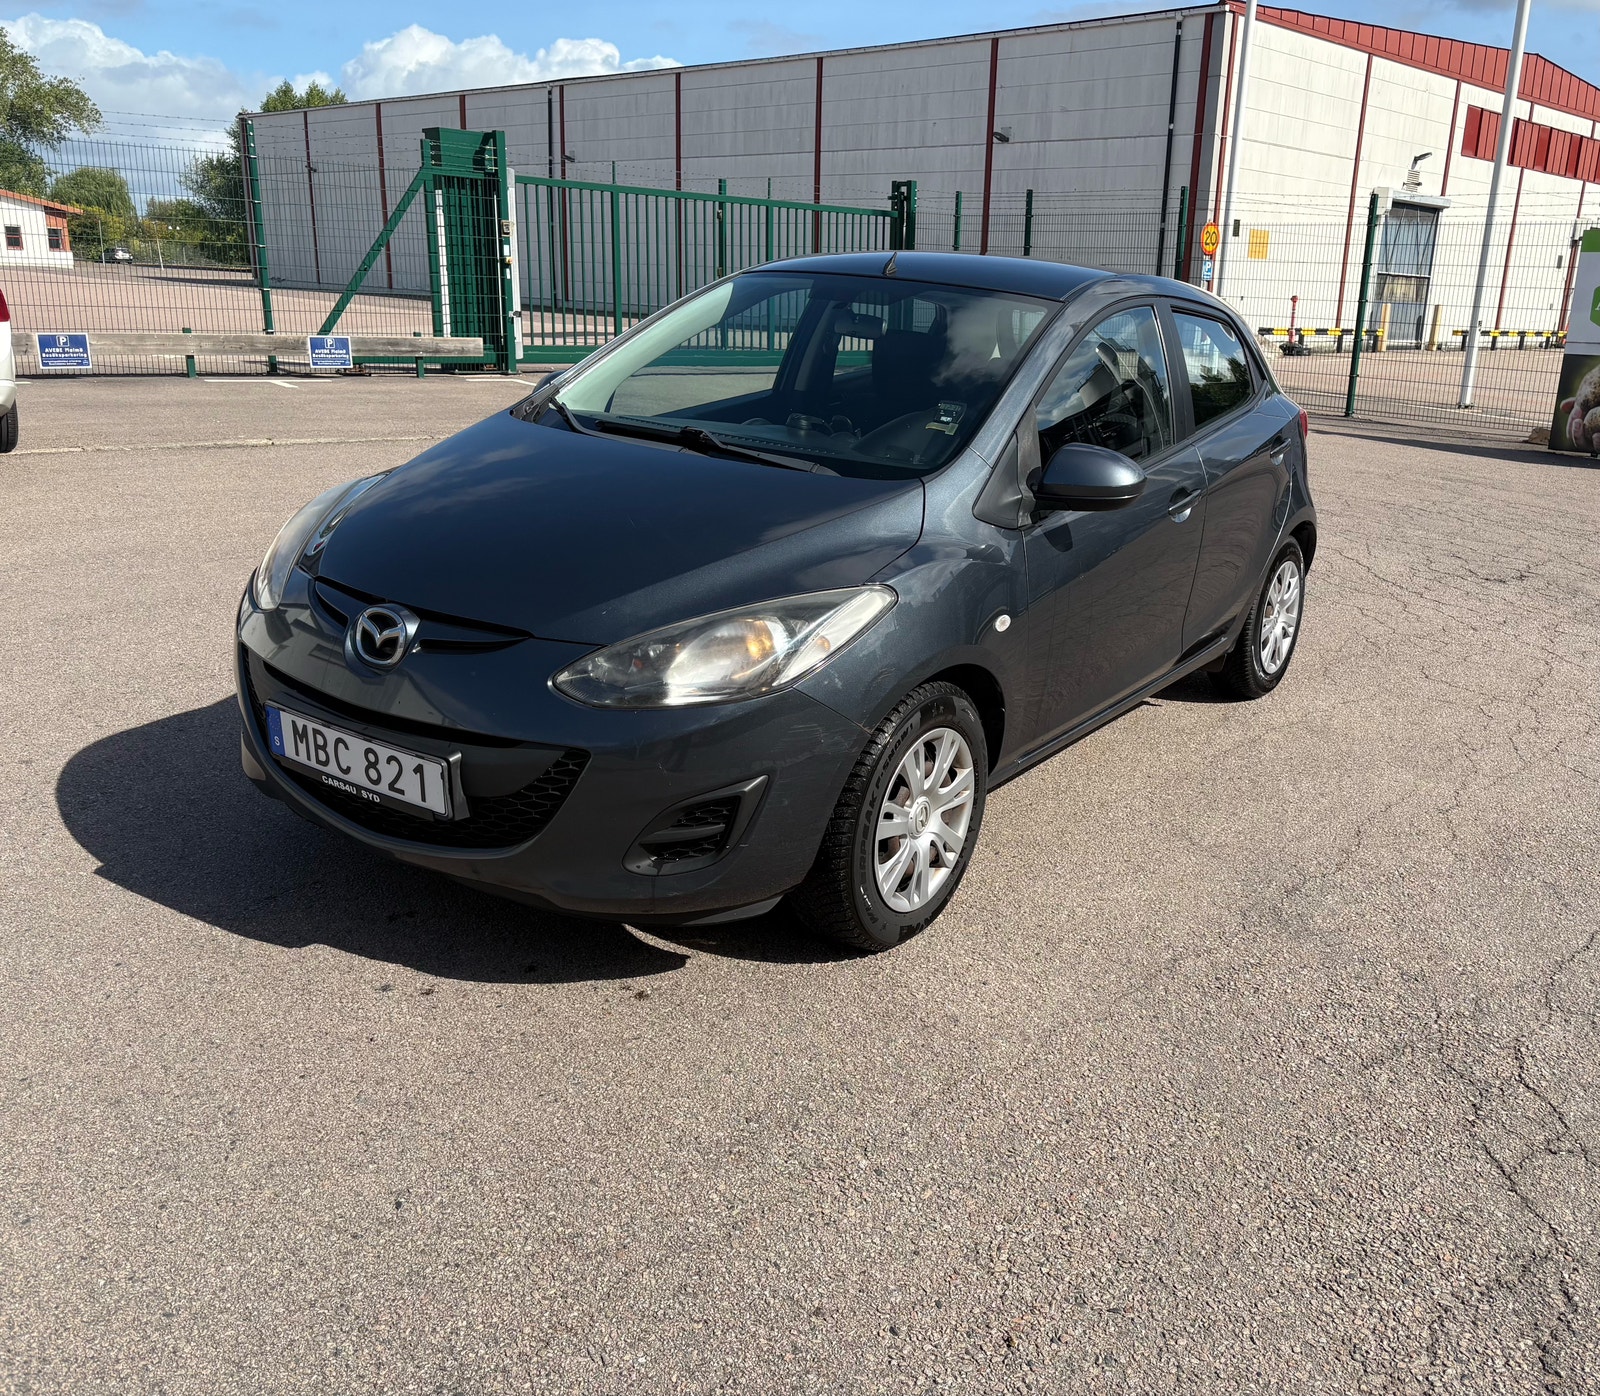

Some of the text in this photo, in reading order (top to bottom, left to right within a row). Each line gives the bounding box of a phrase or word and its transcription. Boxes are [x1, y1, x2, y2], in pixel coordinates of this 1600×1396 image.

[1204, 230, 1218, 247] 20
[1206, 262, 1212, 271] P
[59, 336, 67, 346] P
[274, 735, 281, 747] S
[291, 719, 426, 803] MBC 821
[321, 775, 381, 803] CARS4U SYD
